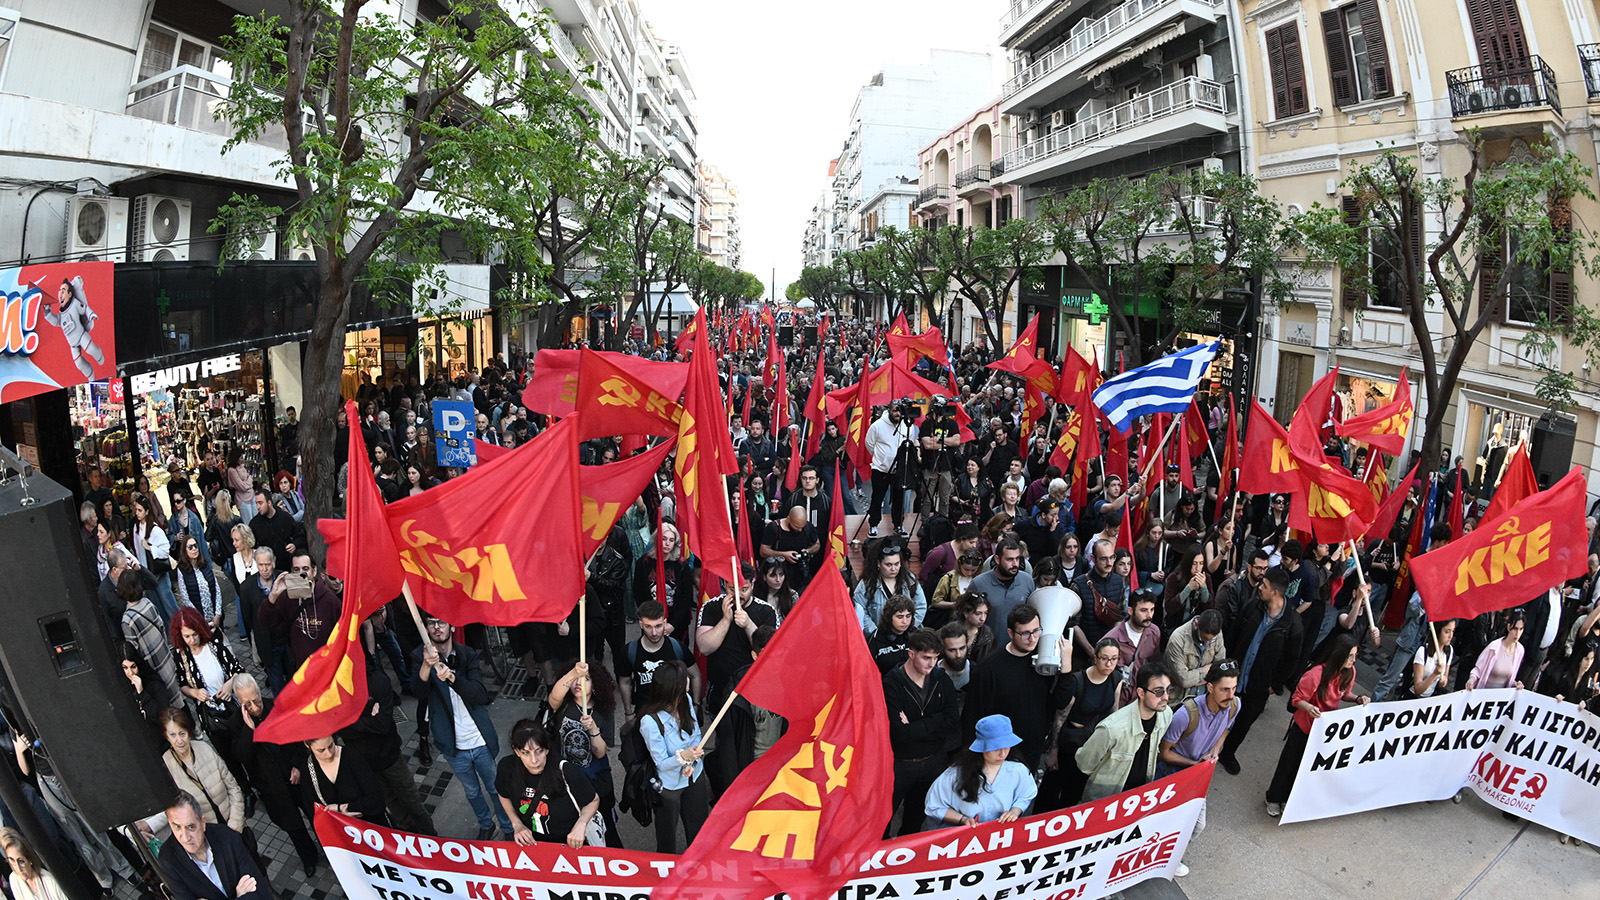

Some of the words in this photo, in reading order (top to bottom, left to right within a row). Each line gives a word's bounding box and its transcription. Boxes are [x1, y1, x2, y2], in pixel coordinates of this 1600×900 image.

[130, 361, 200, 396] BEAUTY
[201, 353, 242, 379] FREE
[442, 410, 466, 434] P
[1455, 520, 1552, 596] ΚΚΕ
[1310, 746, 1355, 772] ΜΕ
[1359, 724, 1506, 765] ΑΝΥΠΑΚΟΗ
[1504, 732, 1549, 762] ΚΑΙ
[1324, 718, 1355, 744] 90
[1360, 703, 1453, 737] ΧΡΟΝΙΑ
[1461, 700, 1516, 721] ΜΕΤΑ
[1521, 705, 1540, 727] Η
[1539, 710, 1600, 752] ΙΣΤΟΡΙ
[1470, 751, 1527, 796] ΚΝΕ
[1484, 786, 1536, 814] ΜΑΚΕΔΟΝΙΑΣ
[343, 826, 386, 852] 90
[390, 833, 541, 873] ΧΡΟΝΙΑ
[551, 853, 640, 877] ΑΠΟ
[928, 831, 1015, 862] ΜΑΗ
[1025, 807, 1096, 844] ΤΟΥ
[1104, 783, 1178, 822] 1936
[359, 858, 404, 882] ΜΕ
[410, 871, 455, 894] ΤΟ
[466, 880, 534, 900] ΚΚΕ
[913, 870, 985, 896] ΣΤΟ
[996, 824, 1143, 881] ΣΥΣΤΗΜΑ
[1108, 837, 1179, 880] ΚΚΕ
